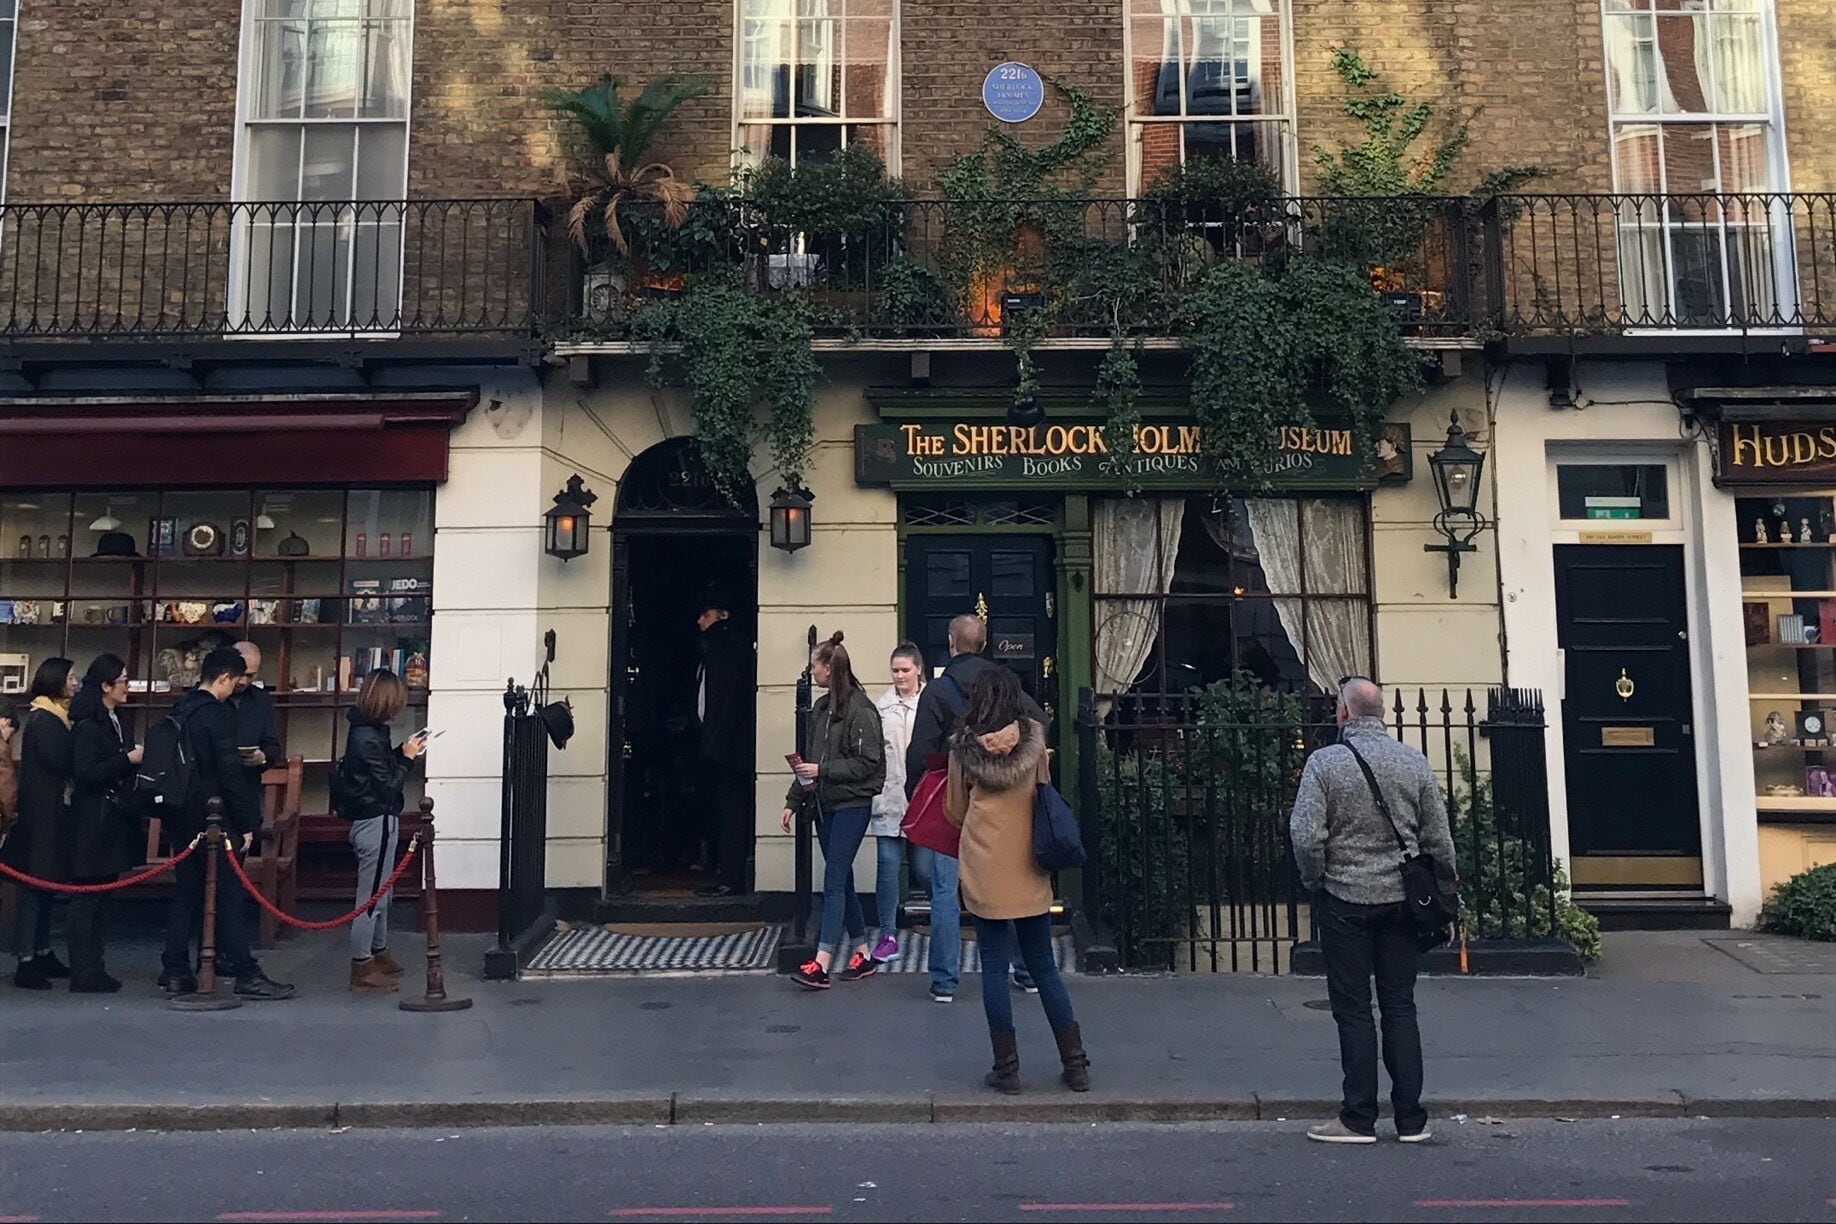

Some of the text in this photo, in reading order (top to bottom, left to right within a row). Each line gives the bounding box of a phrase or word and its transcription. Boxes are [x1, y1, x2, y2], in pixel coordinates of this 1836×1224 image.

[1000, 68, 1027, 80] 221b
[952, 423, 1109, 455] SHERLOCK
[913, 455, 1003, 477] SOUVENIRS
[1022, 456, 1082, 476] BOOKS
[1259, 452, 1313, 474] URIOS
[998, 639, 1023, 652] Open
